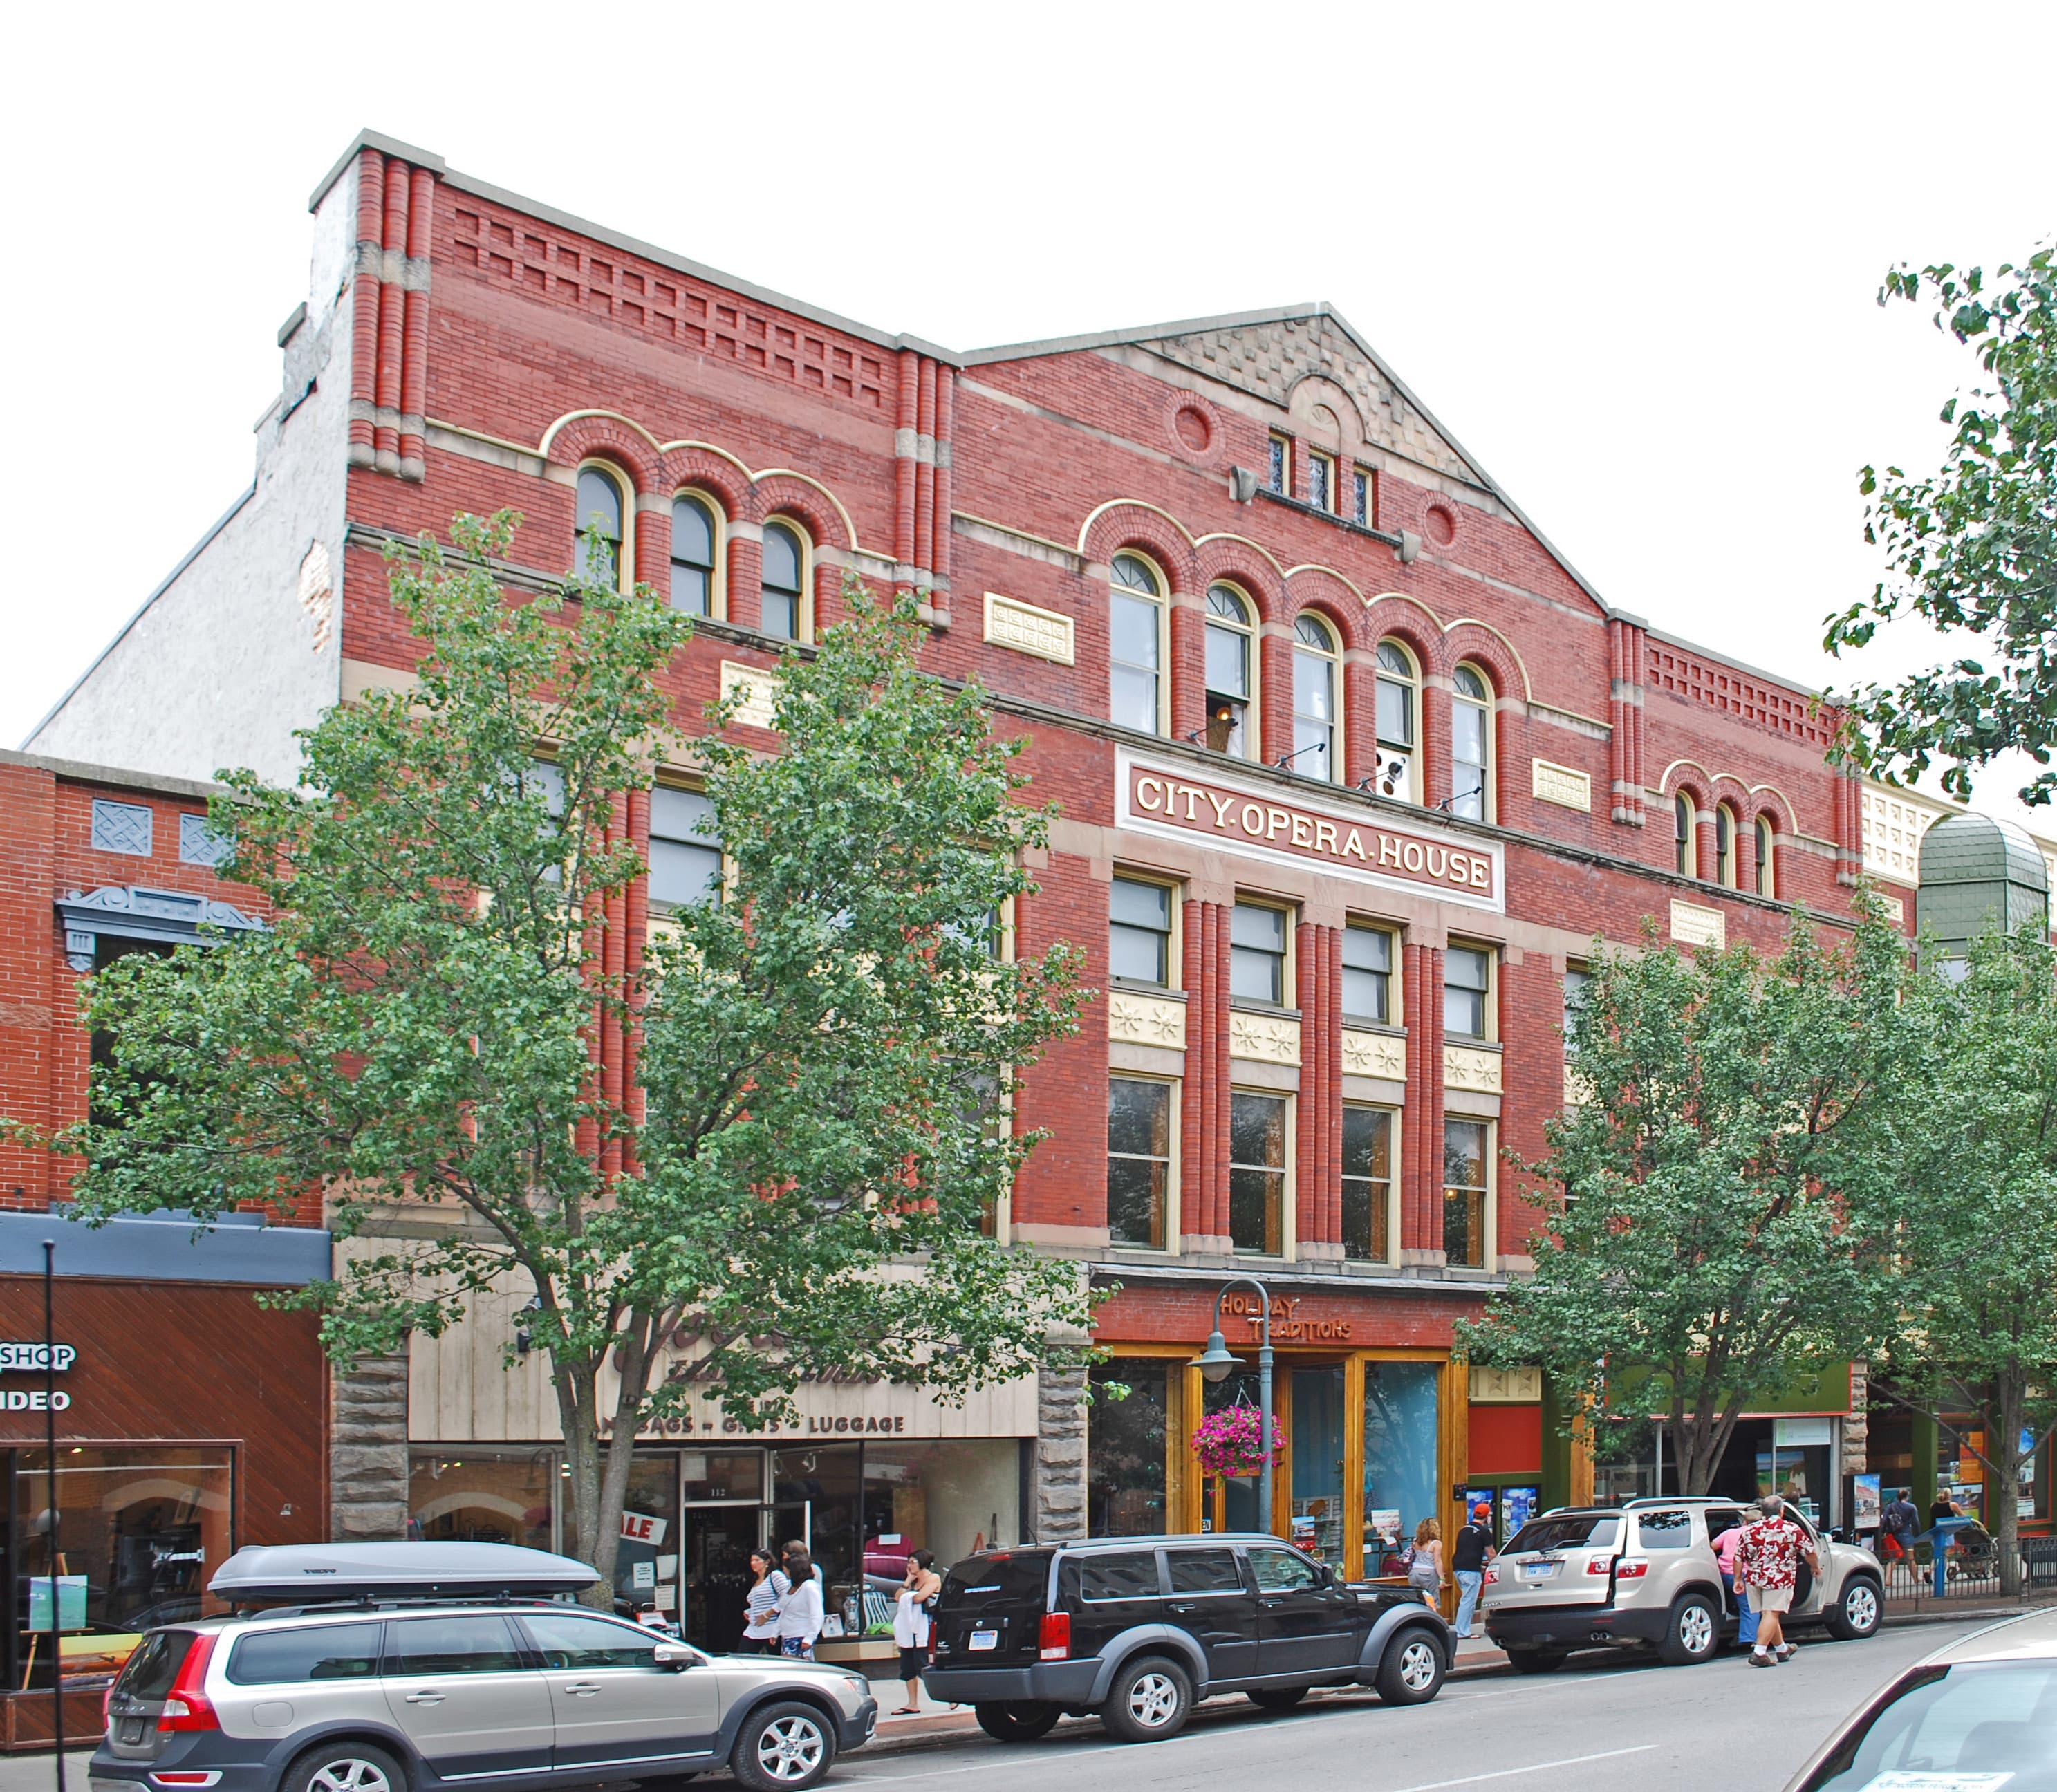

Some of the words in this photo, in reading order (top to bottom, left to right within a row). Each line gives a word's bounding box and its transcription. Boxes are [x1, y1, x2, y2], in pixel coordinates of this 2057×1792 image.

[1136, 776, 1235, 828] CITY
[1241, 803, 1366, 861] OPERA
[1377, 834, 1489, 888] HOUSE
[0, 1344, 75, 1368] SHOP
[809, 1417, 904, 1433] LUGGAGE
[711, 1488, 725, 1497] 112
